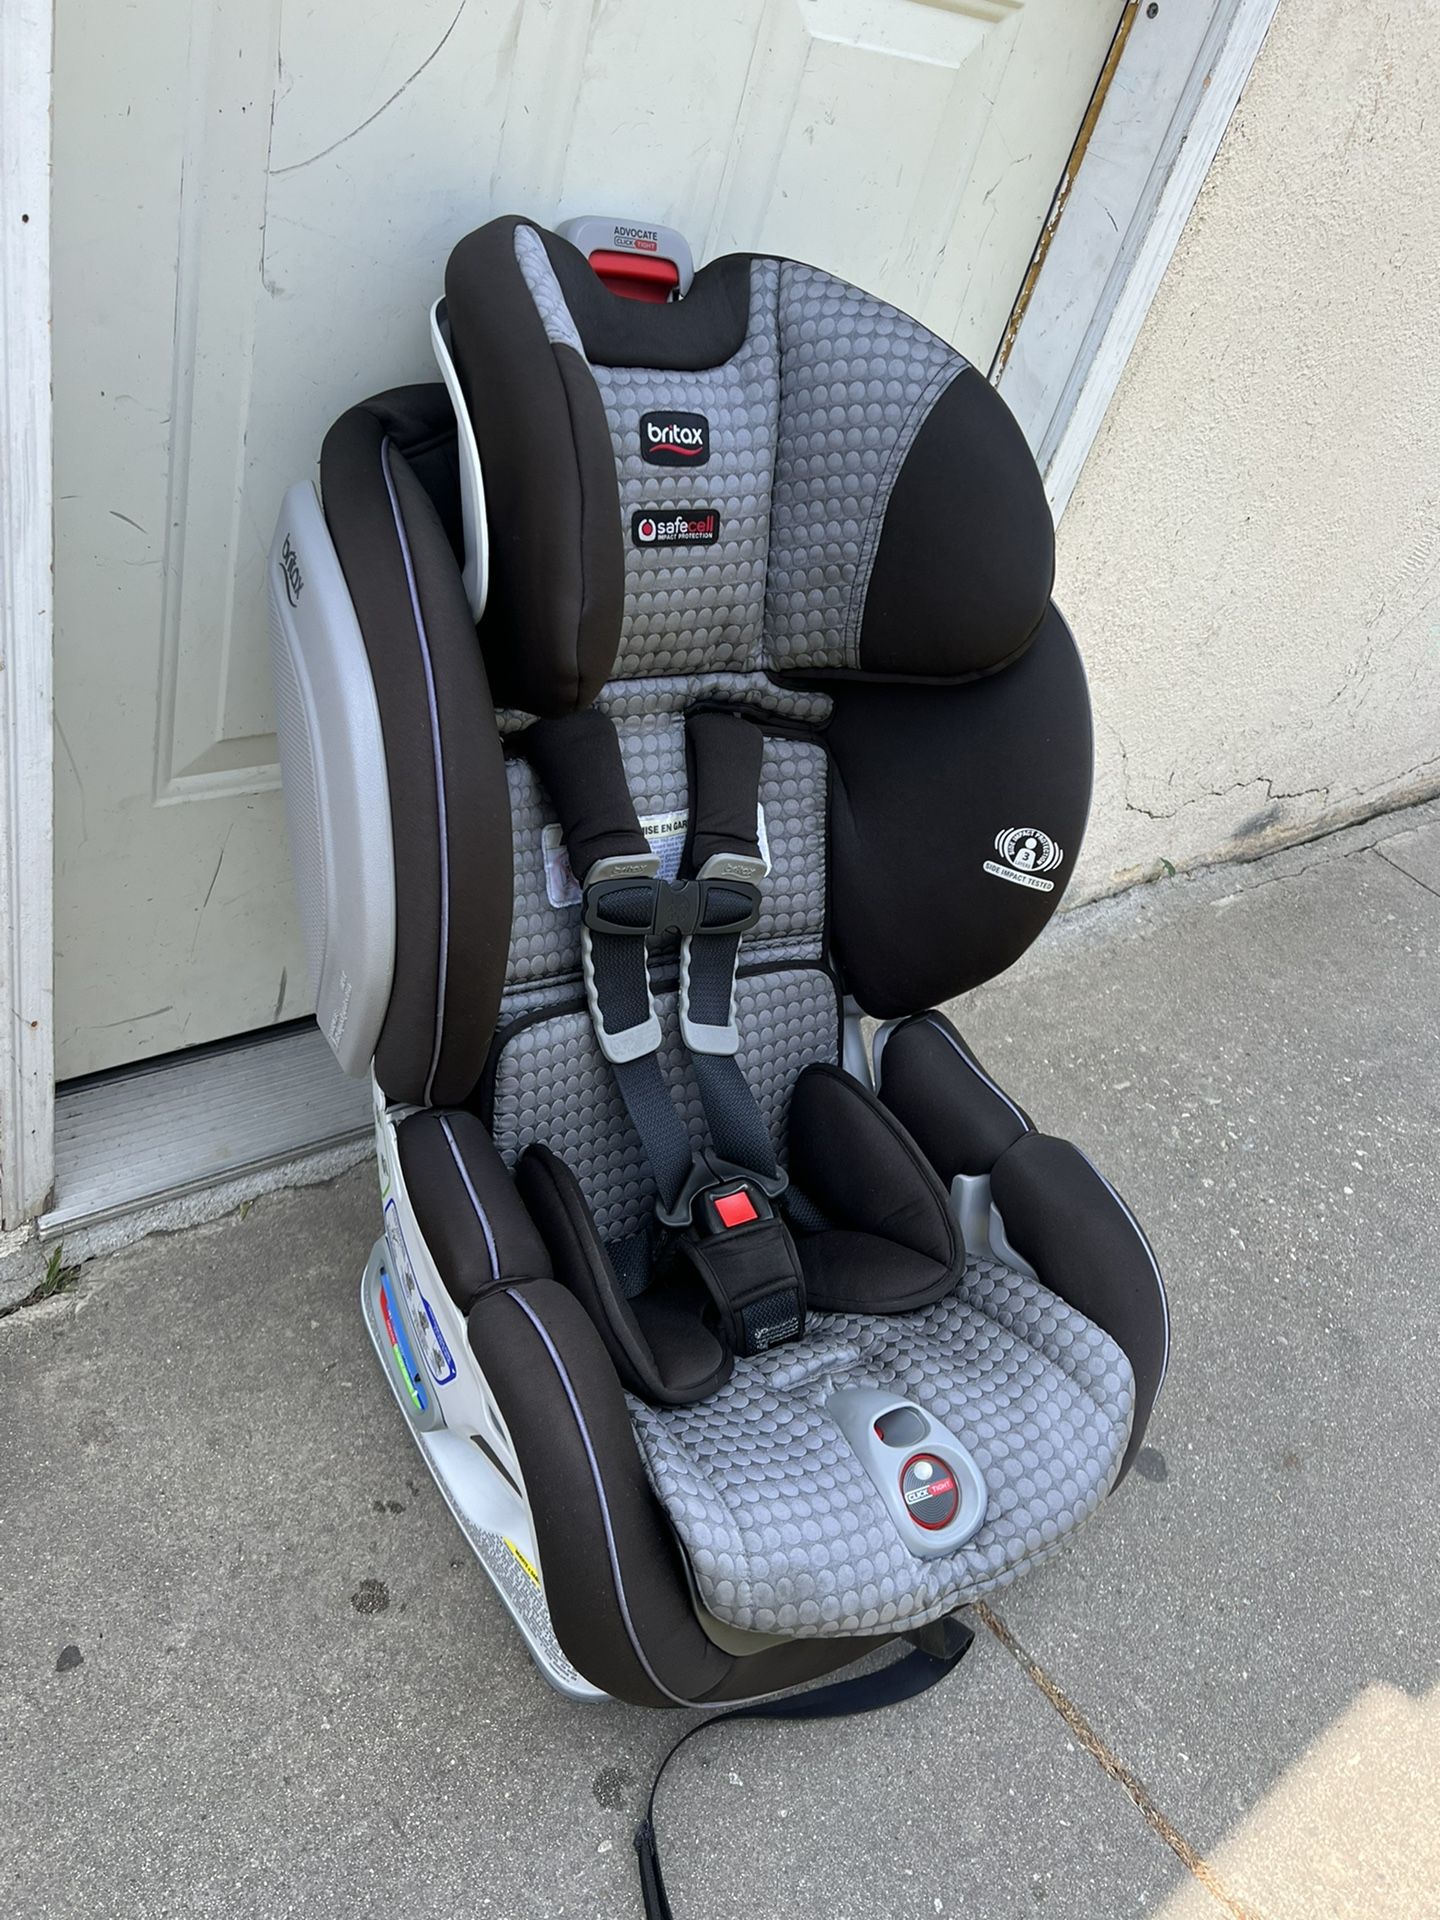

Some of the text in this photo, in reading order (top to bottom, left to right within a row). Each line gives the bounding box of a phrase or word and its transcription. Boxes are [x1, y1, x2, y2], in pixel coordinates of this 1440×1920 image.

[614, 226, 658, 241] ADVOCATE
[616, 237, 656, 249] CLICK TIGHT
[648, 422, 703, 445] britax
[657, 515, 714, 534] safecell
[678, 532, 713, 540] PROTECTION
[282, 532, 304, 600] britax
[661, 823, 672, 833] EN
[1022, 851, 1030, 861] 3
[985, 862, 1052, 890] SIDE IMPACT TESTED
[909, 1481, 951, 1501] CLICK TIGHT
